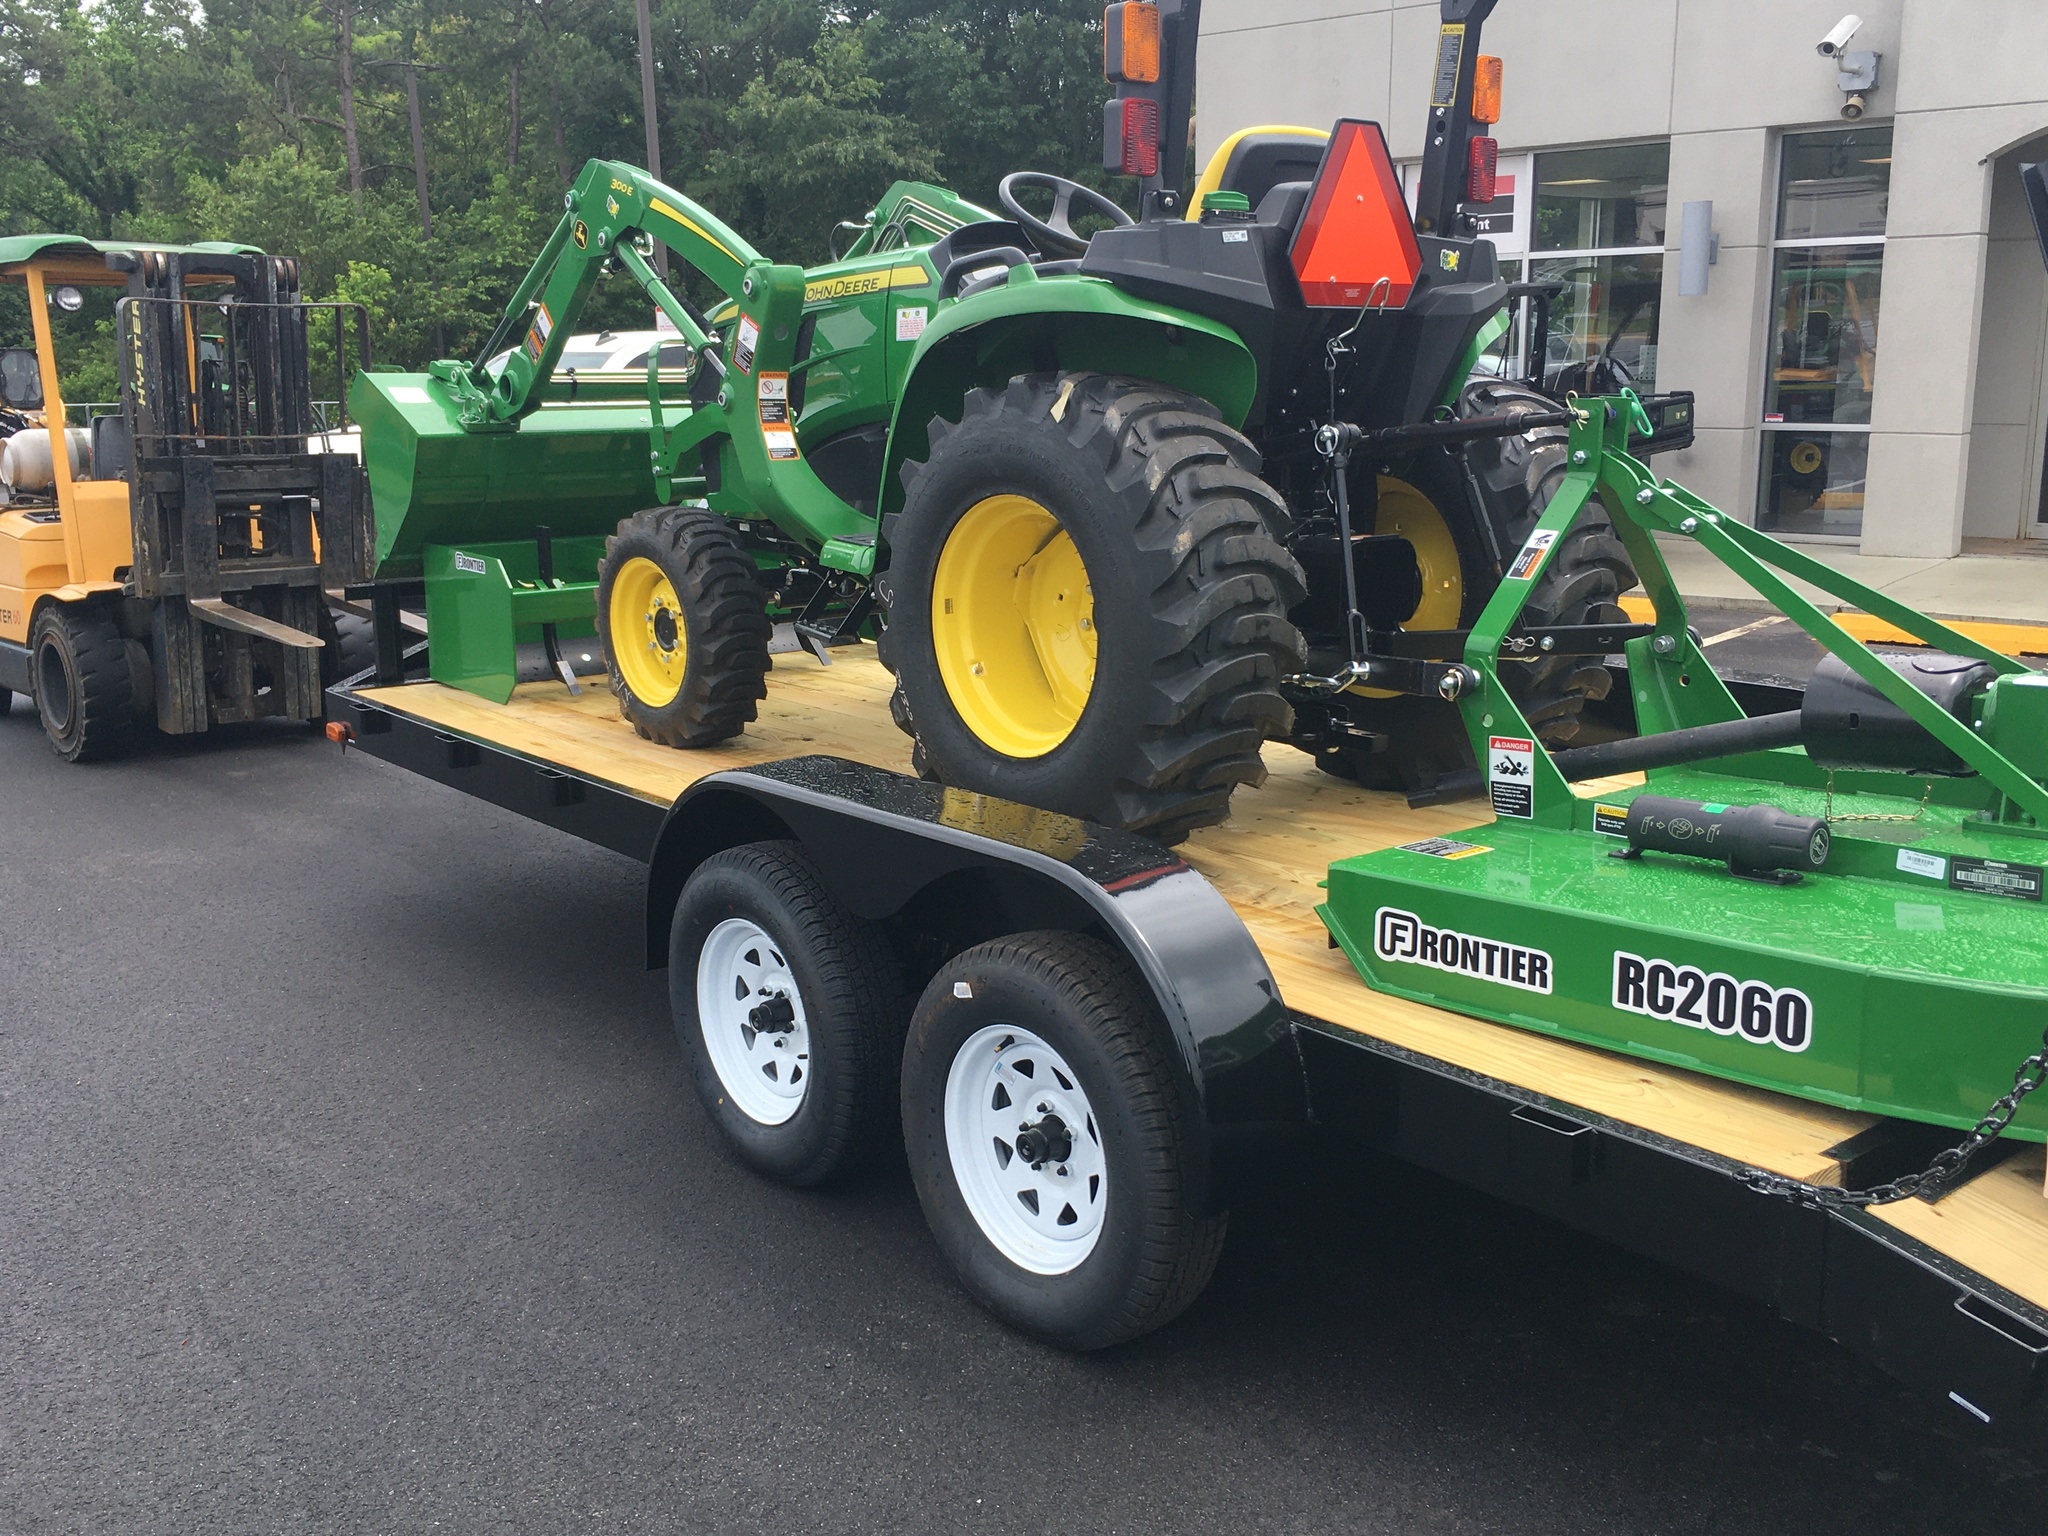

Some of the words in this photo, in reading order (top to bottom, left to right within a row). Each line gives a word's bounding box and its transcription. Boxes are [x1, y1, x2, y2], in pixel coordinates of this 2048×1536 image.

[610, 178, 633, 196] 300E
[806, 285, 833, 301] OHN
[834, 278, 880, 296] DEERE
[131, 300, 146, 406] HYSTER
[456, 553, 485, 573] FRONTIER
[1501, 741, 1529, 751] DANGER
[1603, 808, 1627, 817] CAUTION
[1379, 911, 1548, 989] FRONTIER
[1617, 956, 1807, 1047] RC2060
